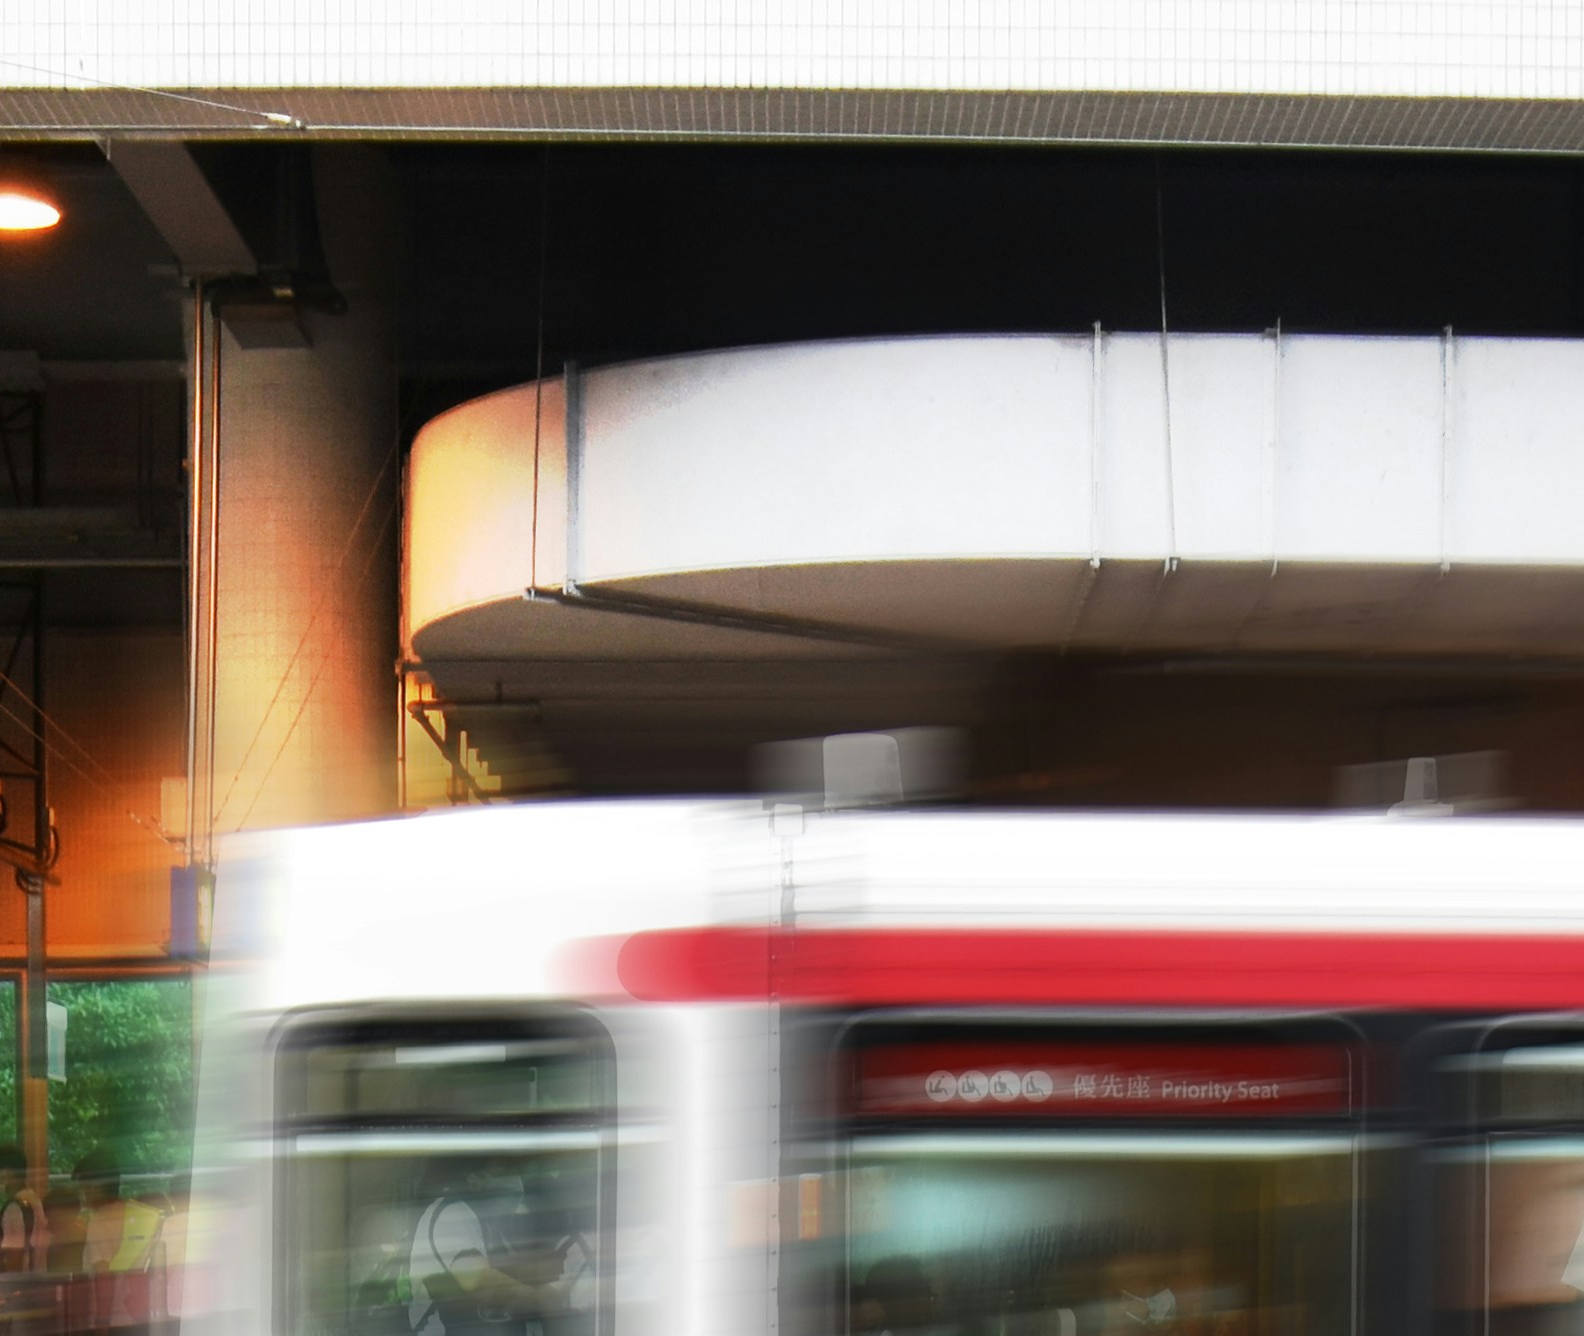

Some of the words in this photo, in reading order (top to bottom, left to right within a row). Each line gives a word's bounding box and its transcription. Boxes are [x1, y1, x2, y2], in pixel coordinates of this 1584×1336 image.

[1073, 1073, 1151, 1099] 優先座
[1162, 1080, 1233, 1103] Priority
[1237, 1080, 1280, 1099] Seat
